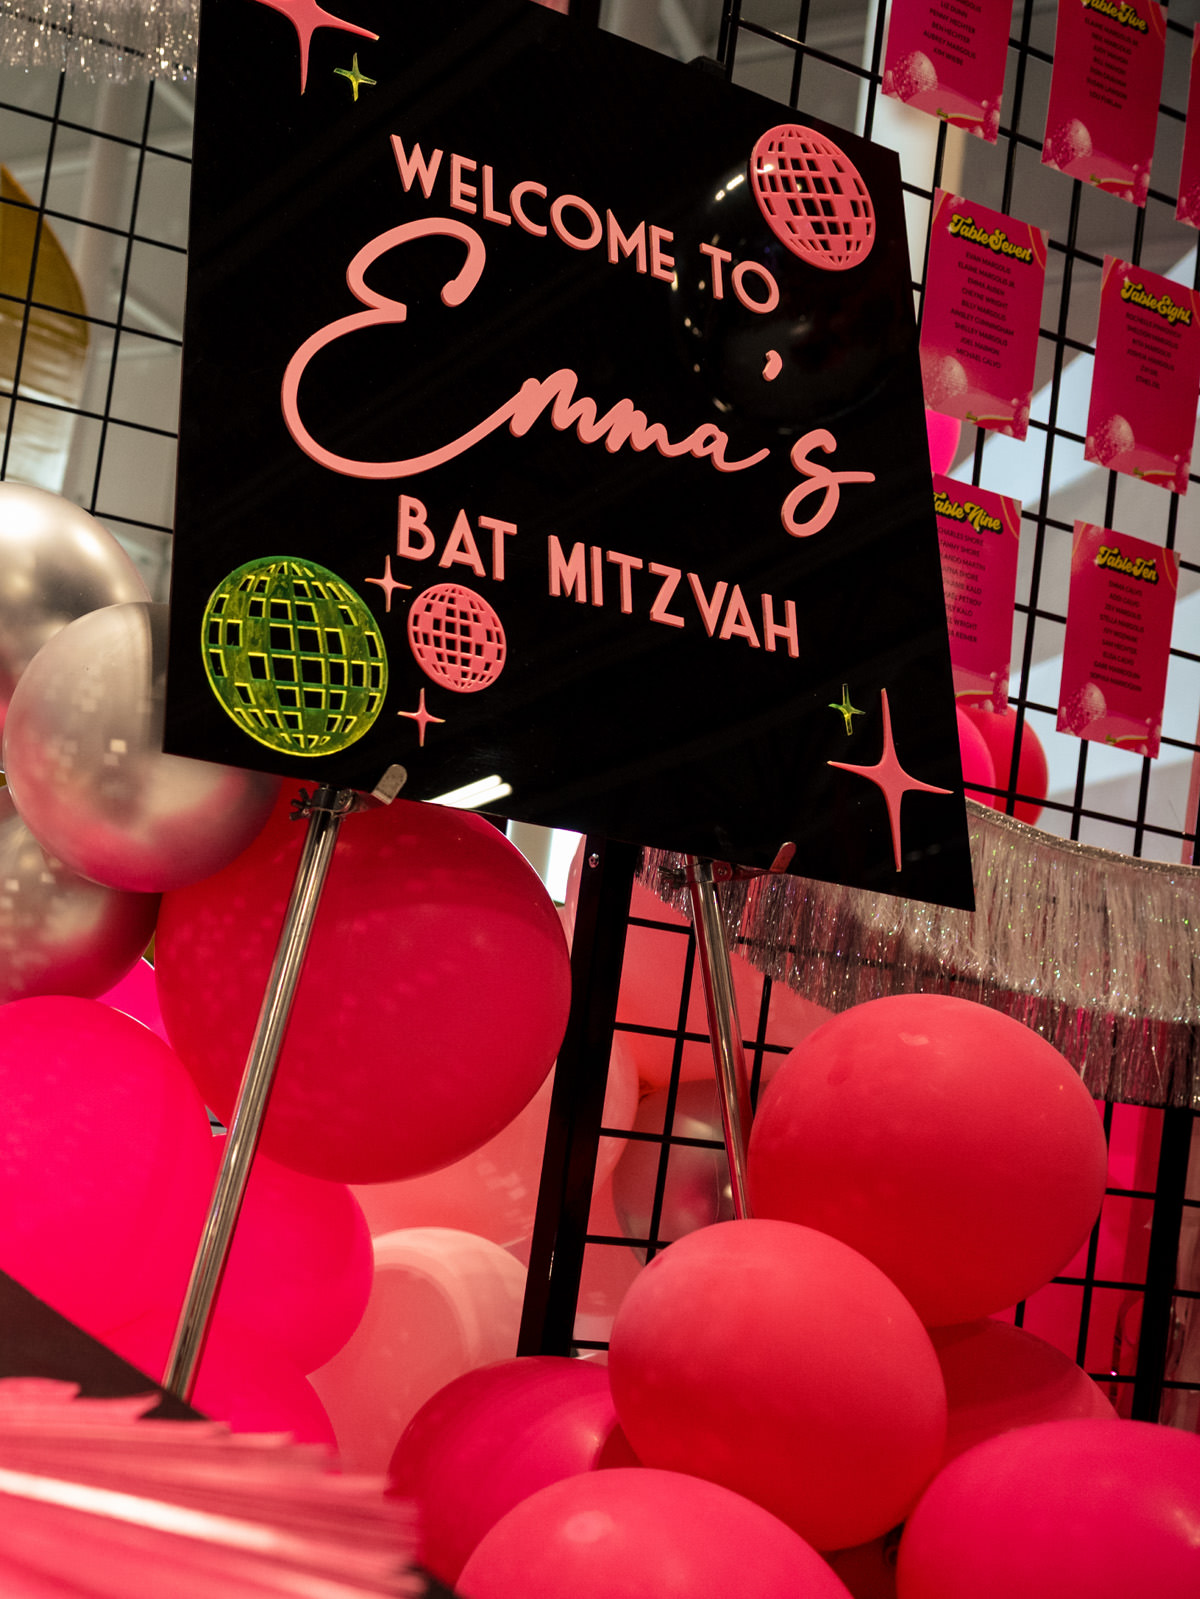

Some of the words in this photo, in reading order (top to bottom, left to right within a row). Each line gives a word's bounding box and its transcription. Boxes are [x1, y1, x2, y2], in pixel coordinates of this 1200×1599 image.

[1117, 3, 1147, 31] Five
[390, 134, 675, 283] WELCOME
[699, 242, 780, 314] TO
[950, 213, 989, 244] Table
[988, 229, 1031, 261] Seven
[982, 258, 1011, 274] MARGOLIS
[978, 305, 1006, 321] MARGOLIS
[1121, 280, 1157, 309] Table
[1156, 295, 1191, 323] Eight
[281, 217, 875, 538] Emma's
[963, 501, 1001, 530] Nine
[397, 494, 518, 581] BAT
[547, 534, 799, 658] MITZVAH
[1098, 545, 1133, 573] Table
[1132, 558, 1157, 581] Ten
